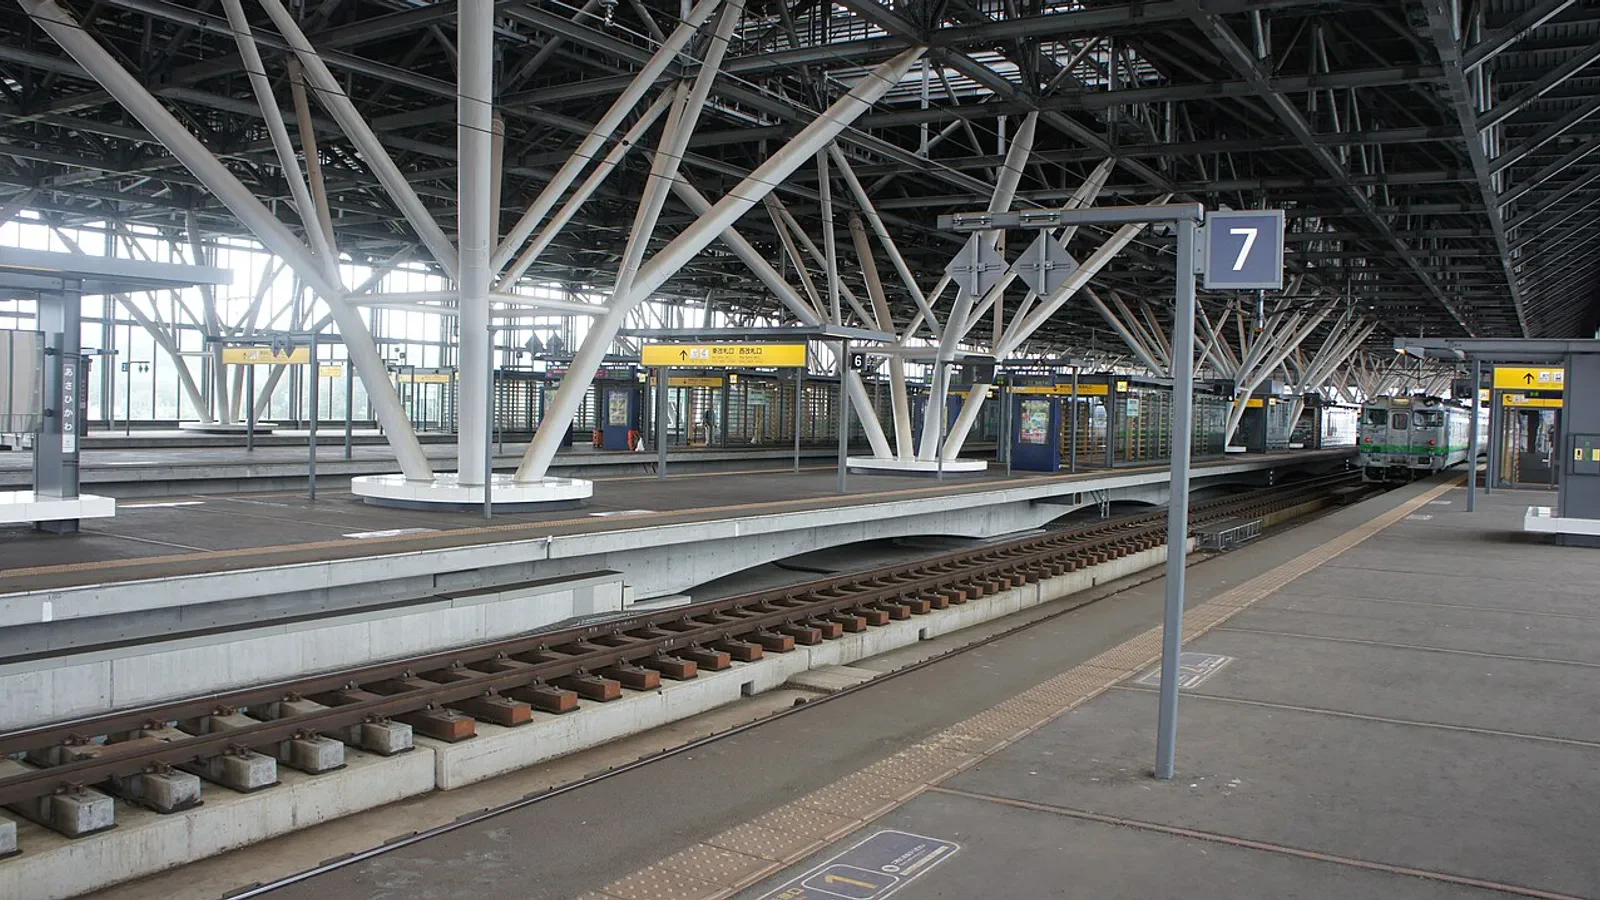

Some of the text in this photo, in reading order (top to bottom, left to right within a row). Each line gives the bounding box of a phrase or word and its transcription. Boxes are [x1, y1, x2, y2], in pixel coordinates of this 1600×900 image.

[1230, 228, 1257, 270] 7
[855, 355, 861, 367] 6
[64, 367, 73, 431] あさひかわ
[825, 874, 876, 889] 1
